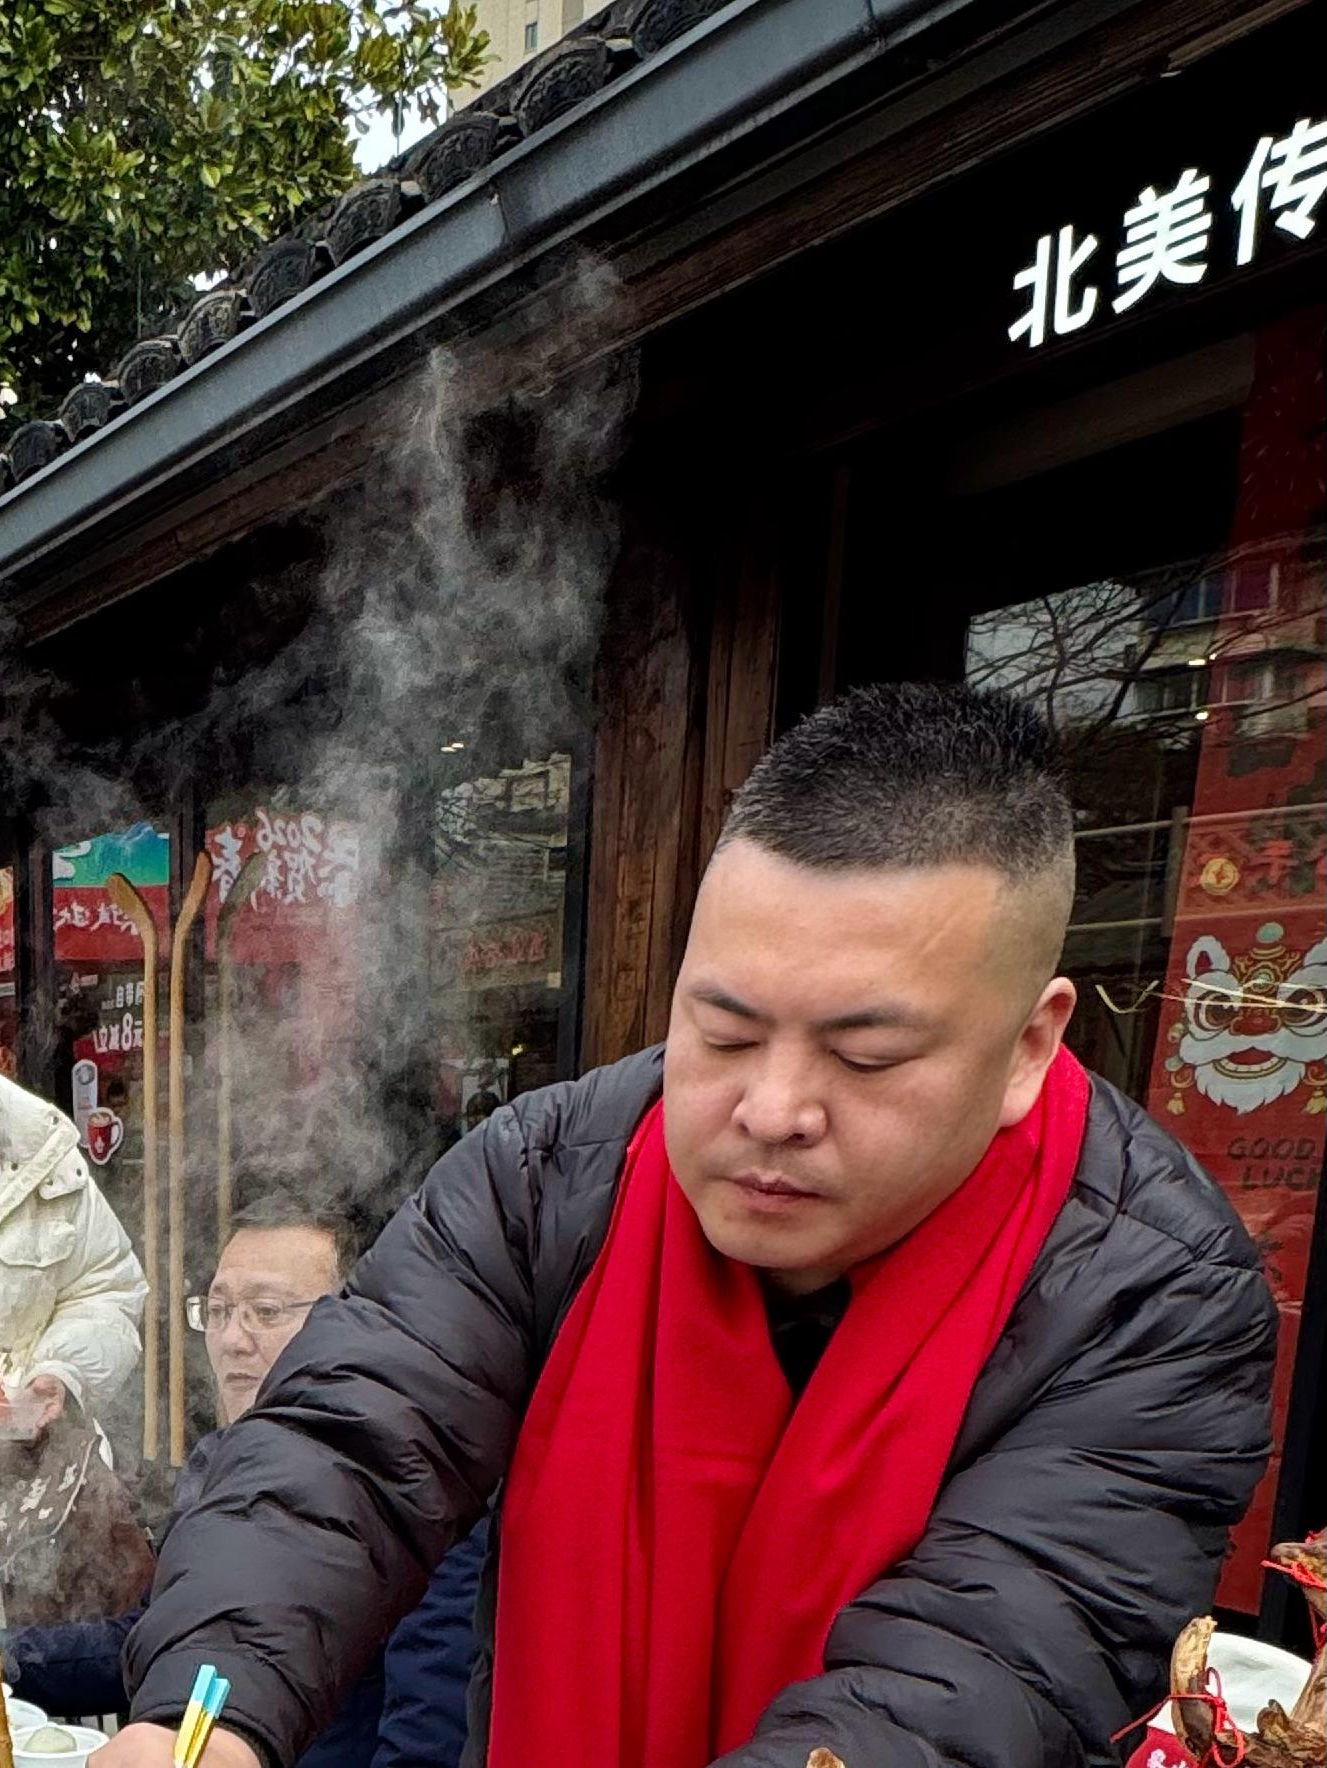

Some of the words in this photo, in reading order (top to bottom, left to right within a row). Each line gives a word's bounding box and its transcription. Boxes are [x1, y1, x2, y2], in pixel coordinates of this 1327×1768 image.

[1008, 118, 1327, 347] 北美传
[1227, 1136, 1315, 1159] GOOD
